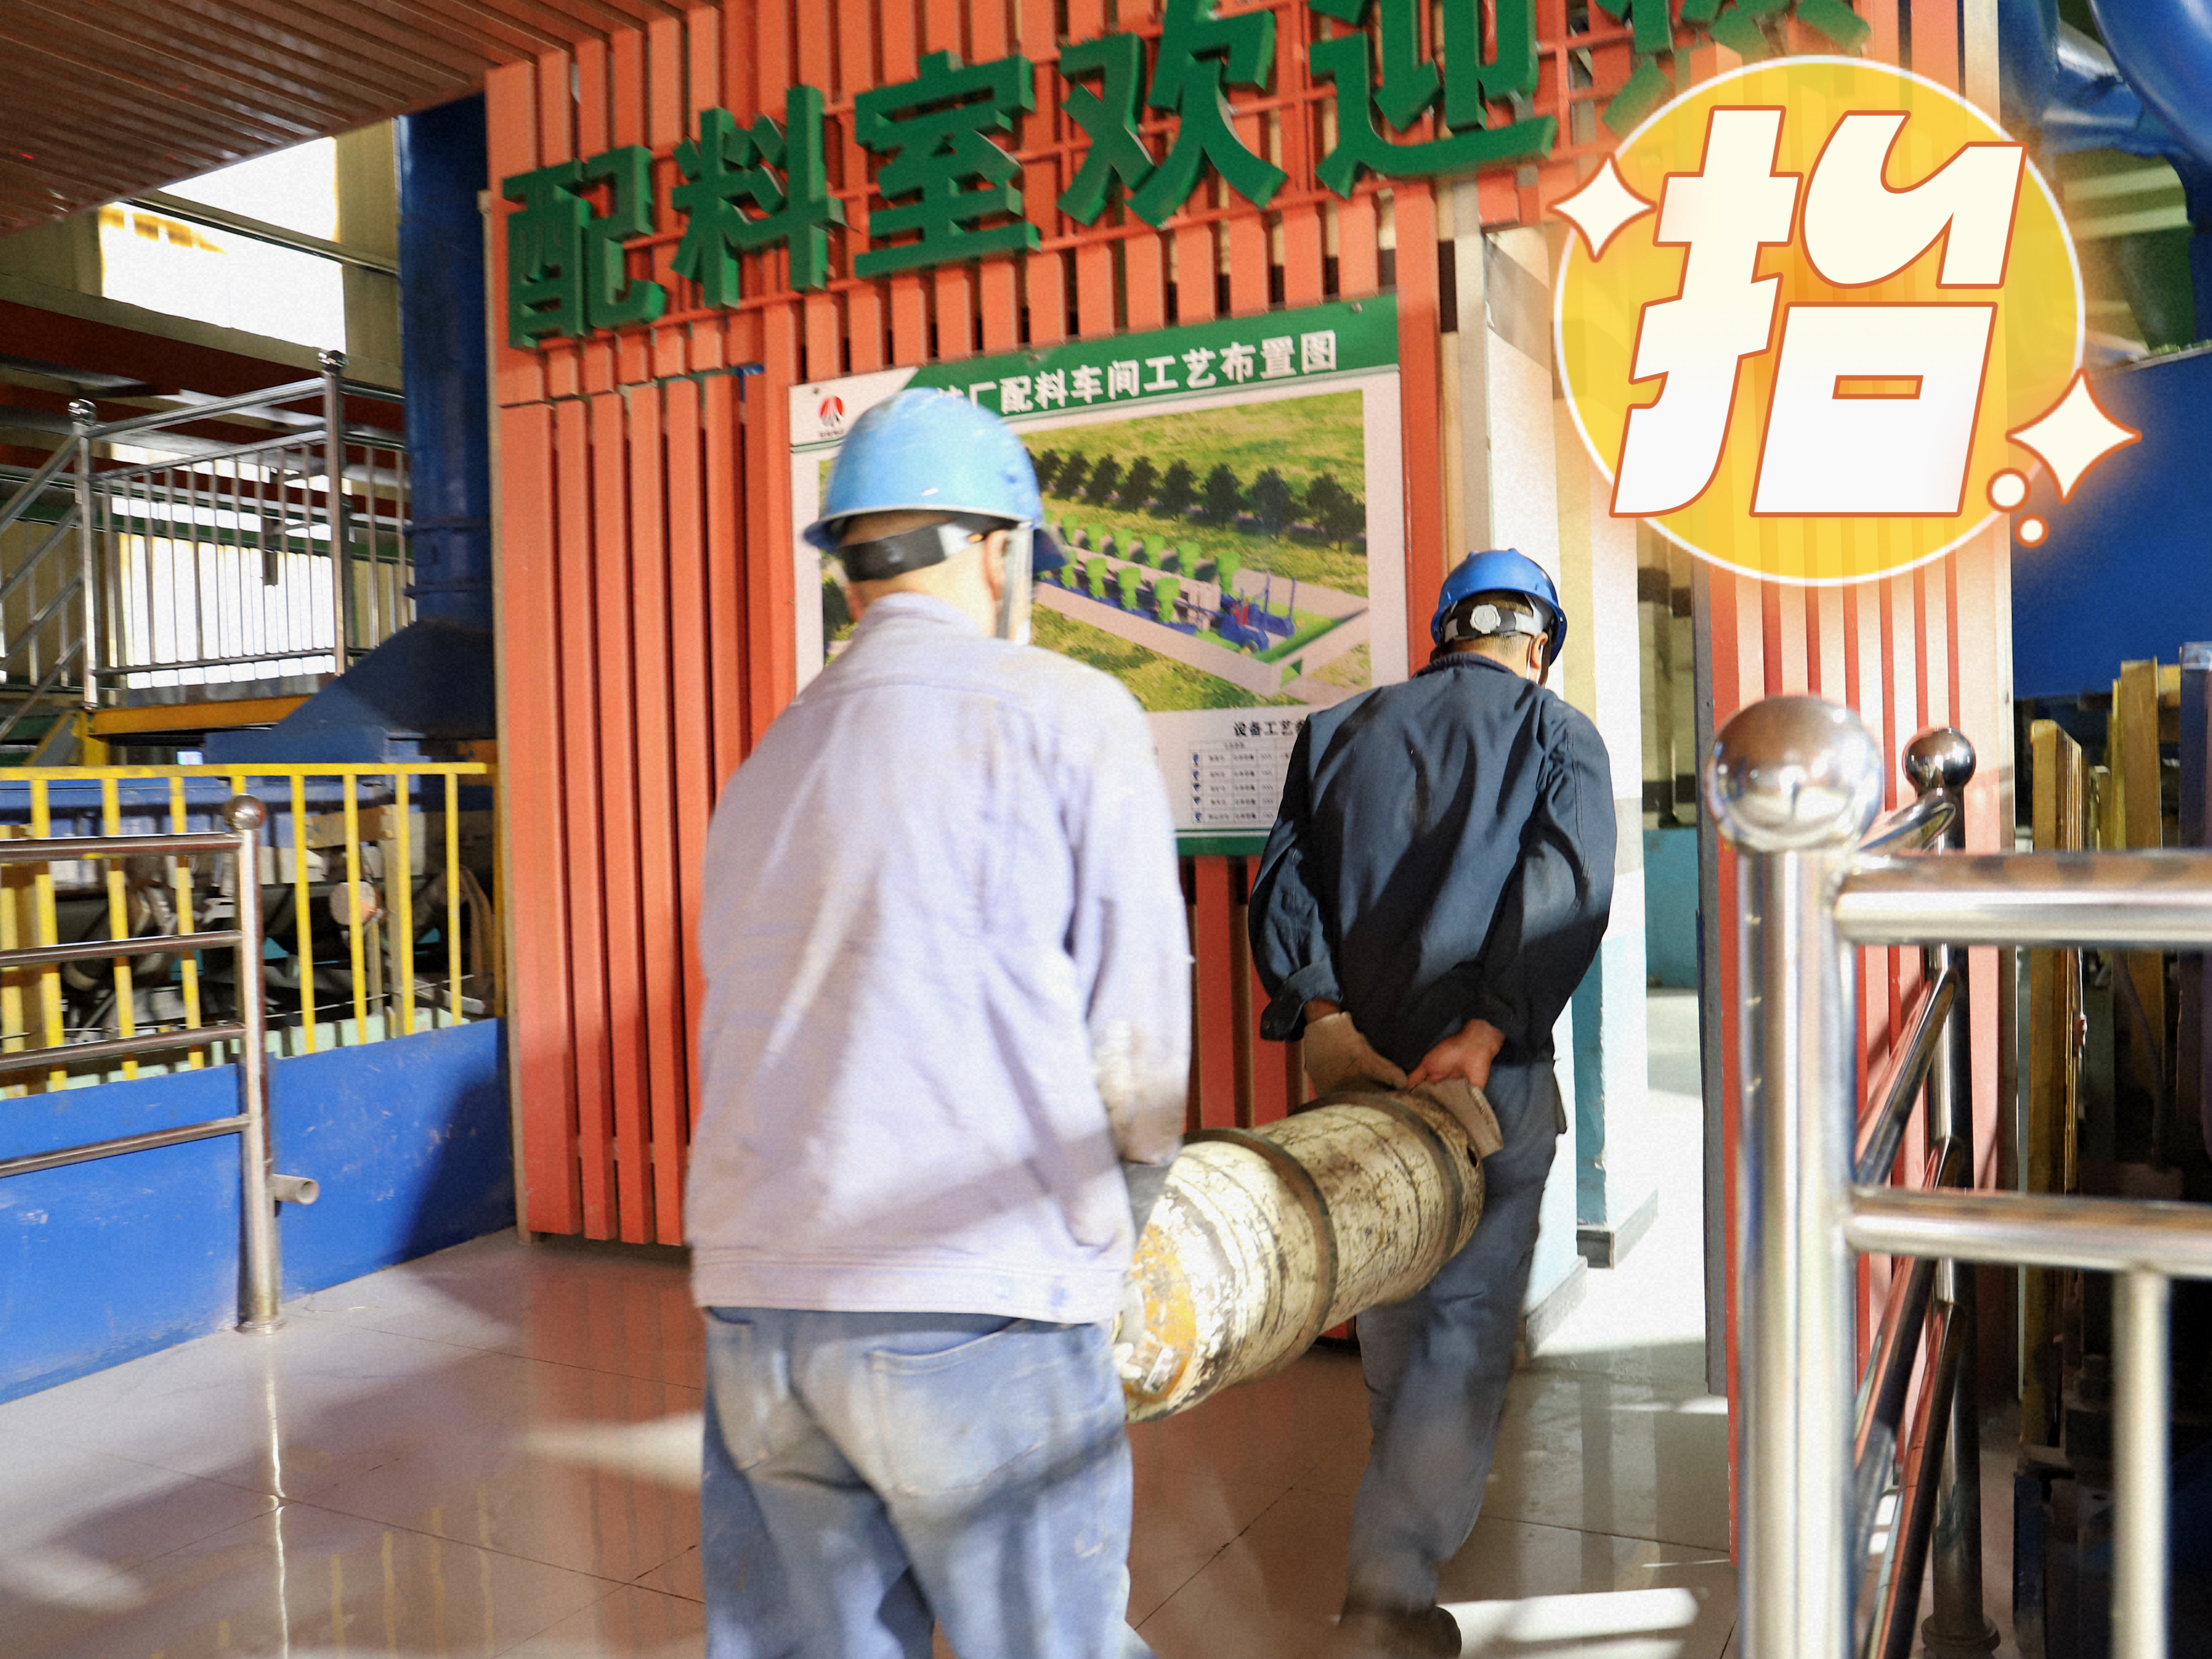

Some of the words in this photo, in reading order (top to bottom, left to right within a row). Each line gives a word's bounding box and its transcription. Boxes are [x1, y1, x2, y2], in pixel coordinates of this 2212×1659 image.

[937, 330, 1337, 415] 厂配料车间工艺布置图
